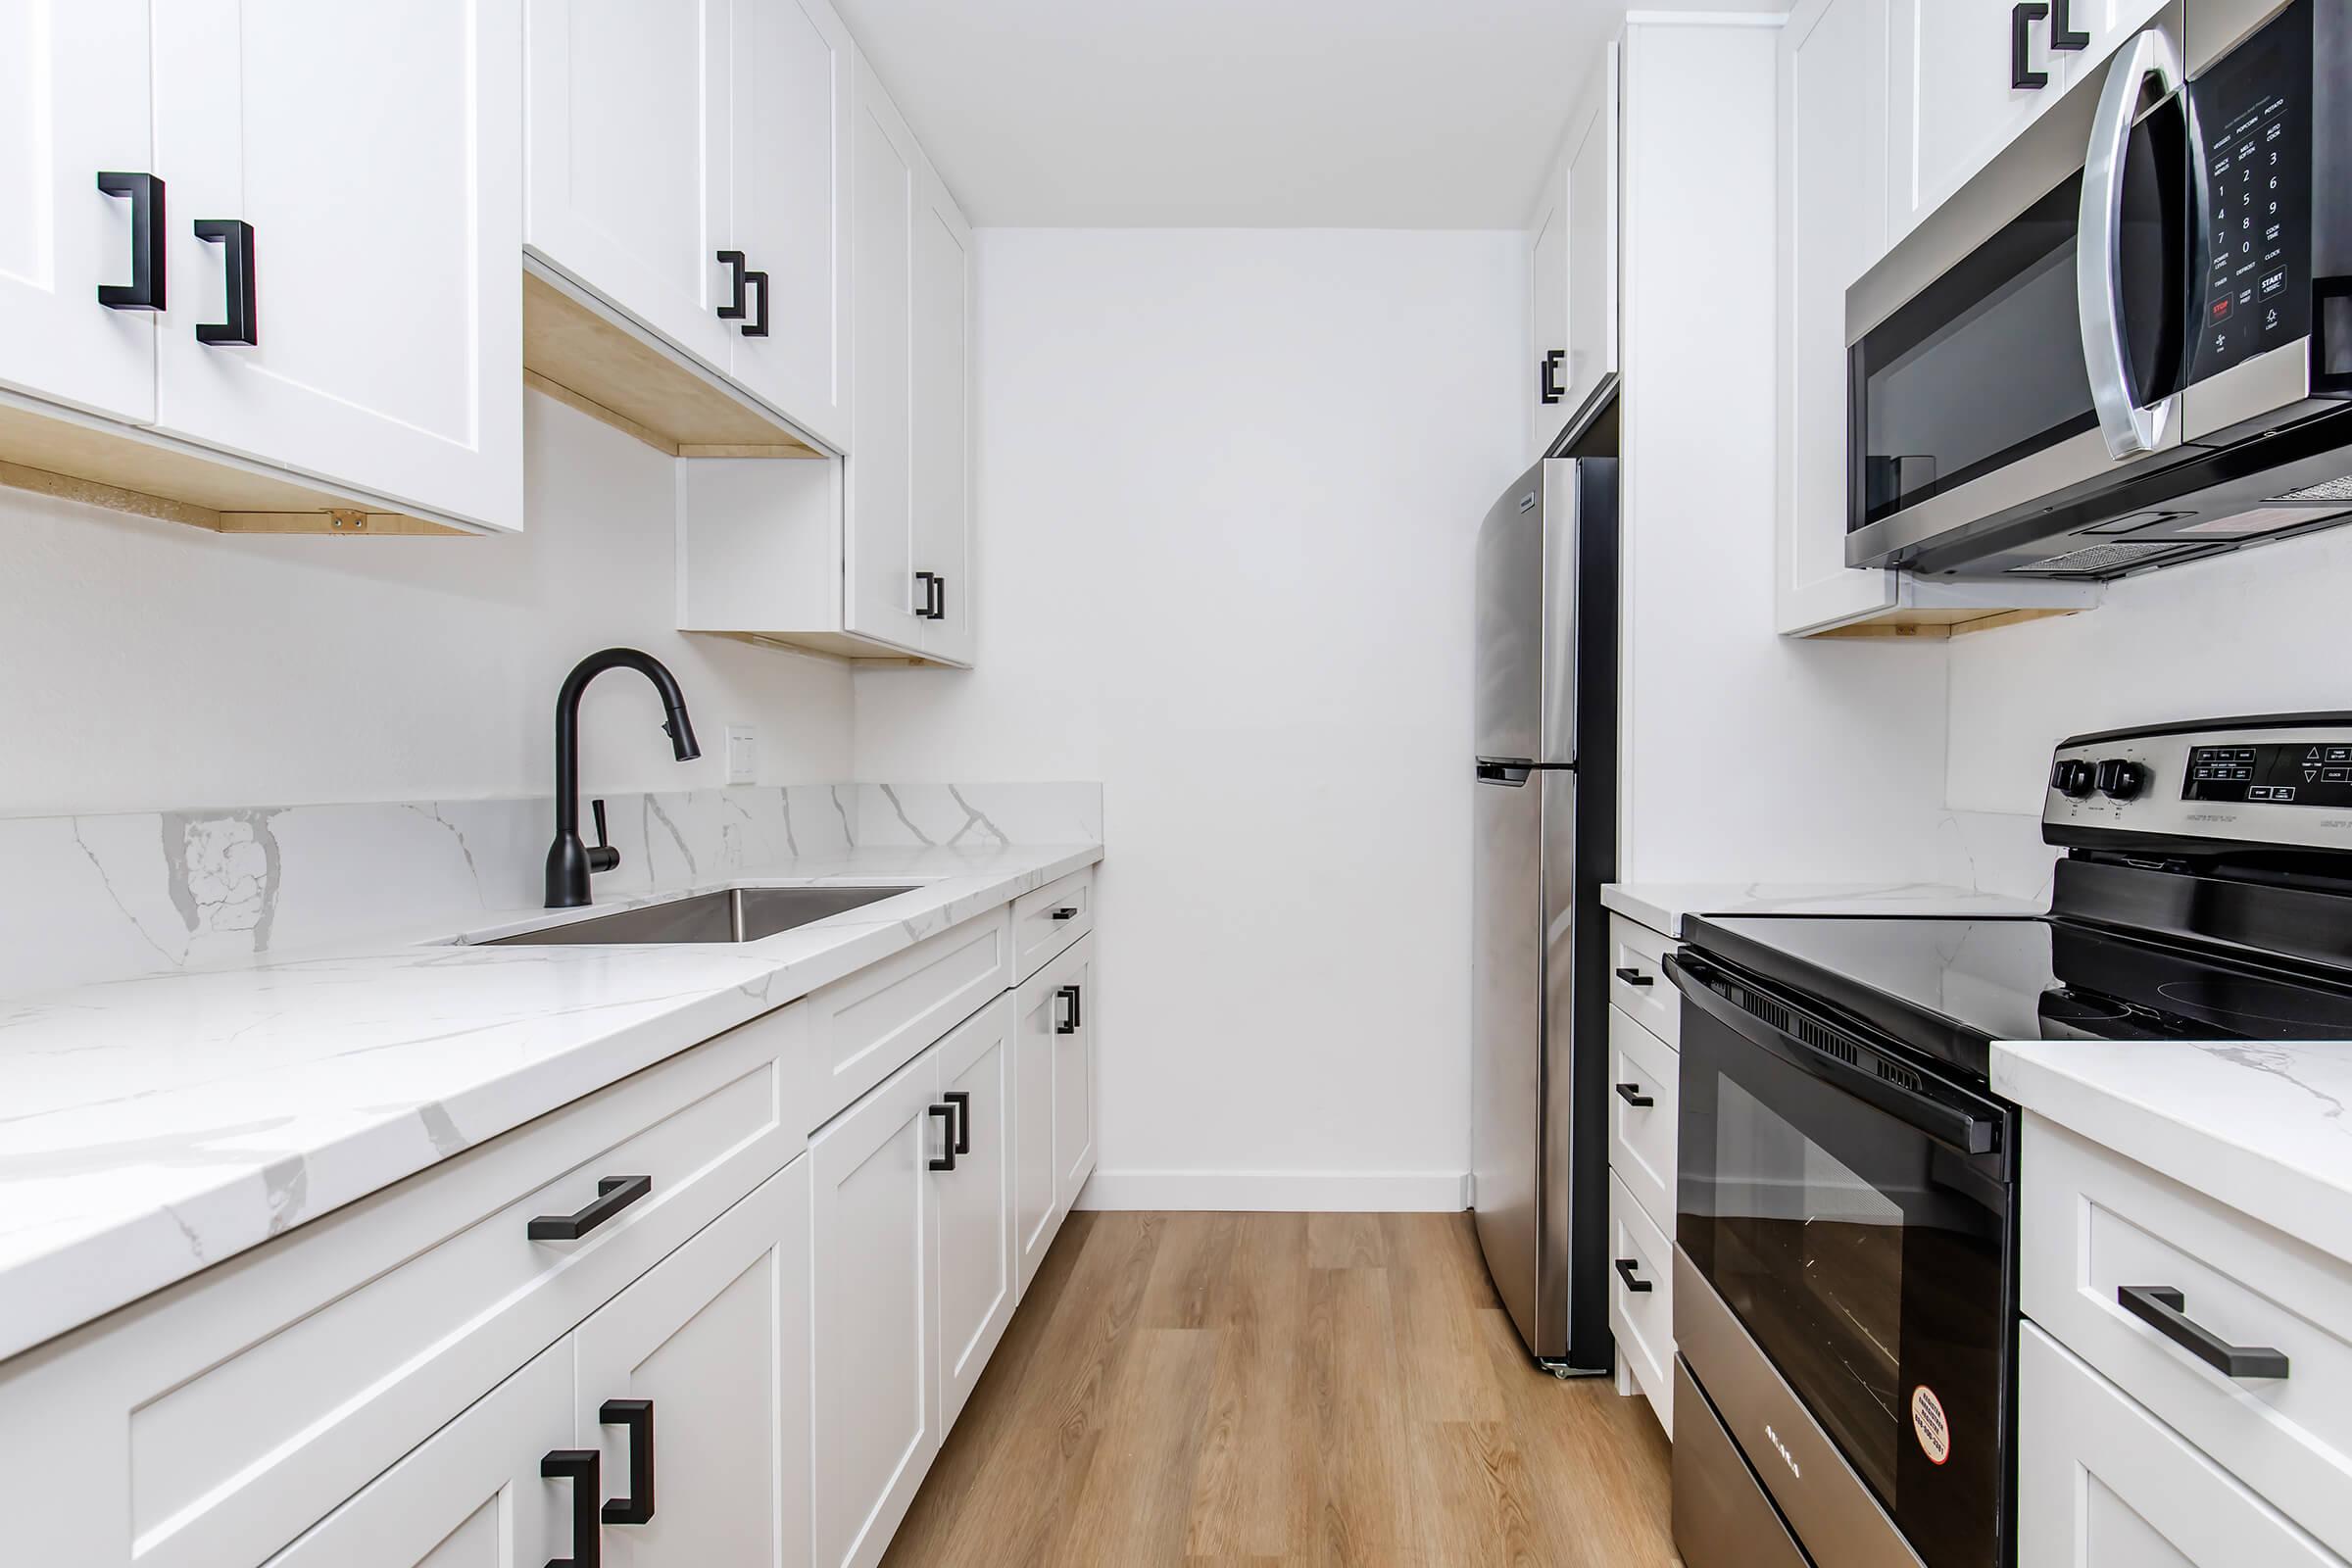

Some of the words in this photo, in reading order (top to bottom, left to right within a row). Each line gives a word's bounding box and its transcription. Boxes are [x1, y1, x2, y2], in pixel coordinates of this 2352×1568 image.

[2264, 98, 2283, 115] POTATO
[2236, 116, 2258, 133] POPCORN
[2267, 122, 2280, 135] AUTO
[2267, 129, 2281, 142] COOK
[2270, 152, 2277, 166] 3
[2242, 169, 2250, 182] 2
[2270, 176, 2278, 189] 6
[2219, 185, 2224, 197] 1
[2243, 192, 2250, 206] 5
[2218, 208, 2225, 220] 4
[2269, 201, 2277, 215] 9
[2242, 217, 2250, 229] 8
[2218, 231, 2225, 244] 7
[2242, 241, 2250, 253] 0
[2264, 248, 2280, 261] CLOCK
[2262, 271, 2283, 289] START
